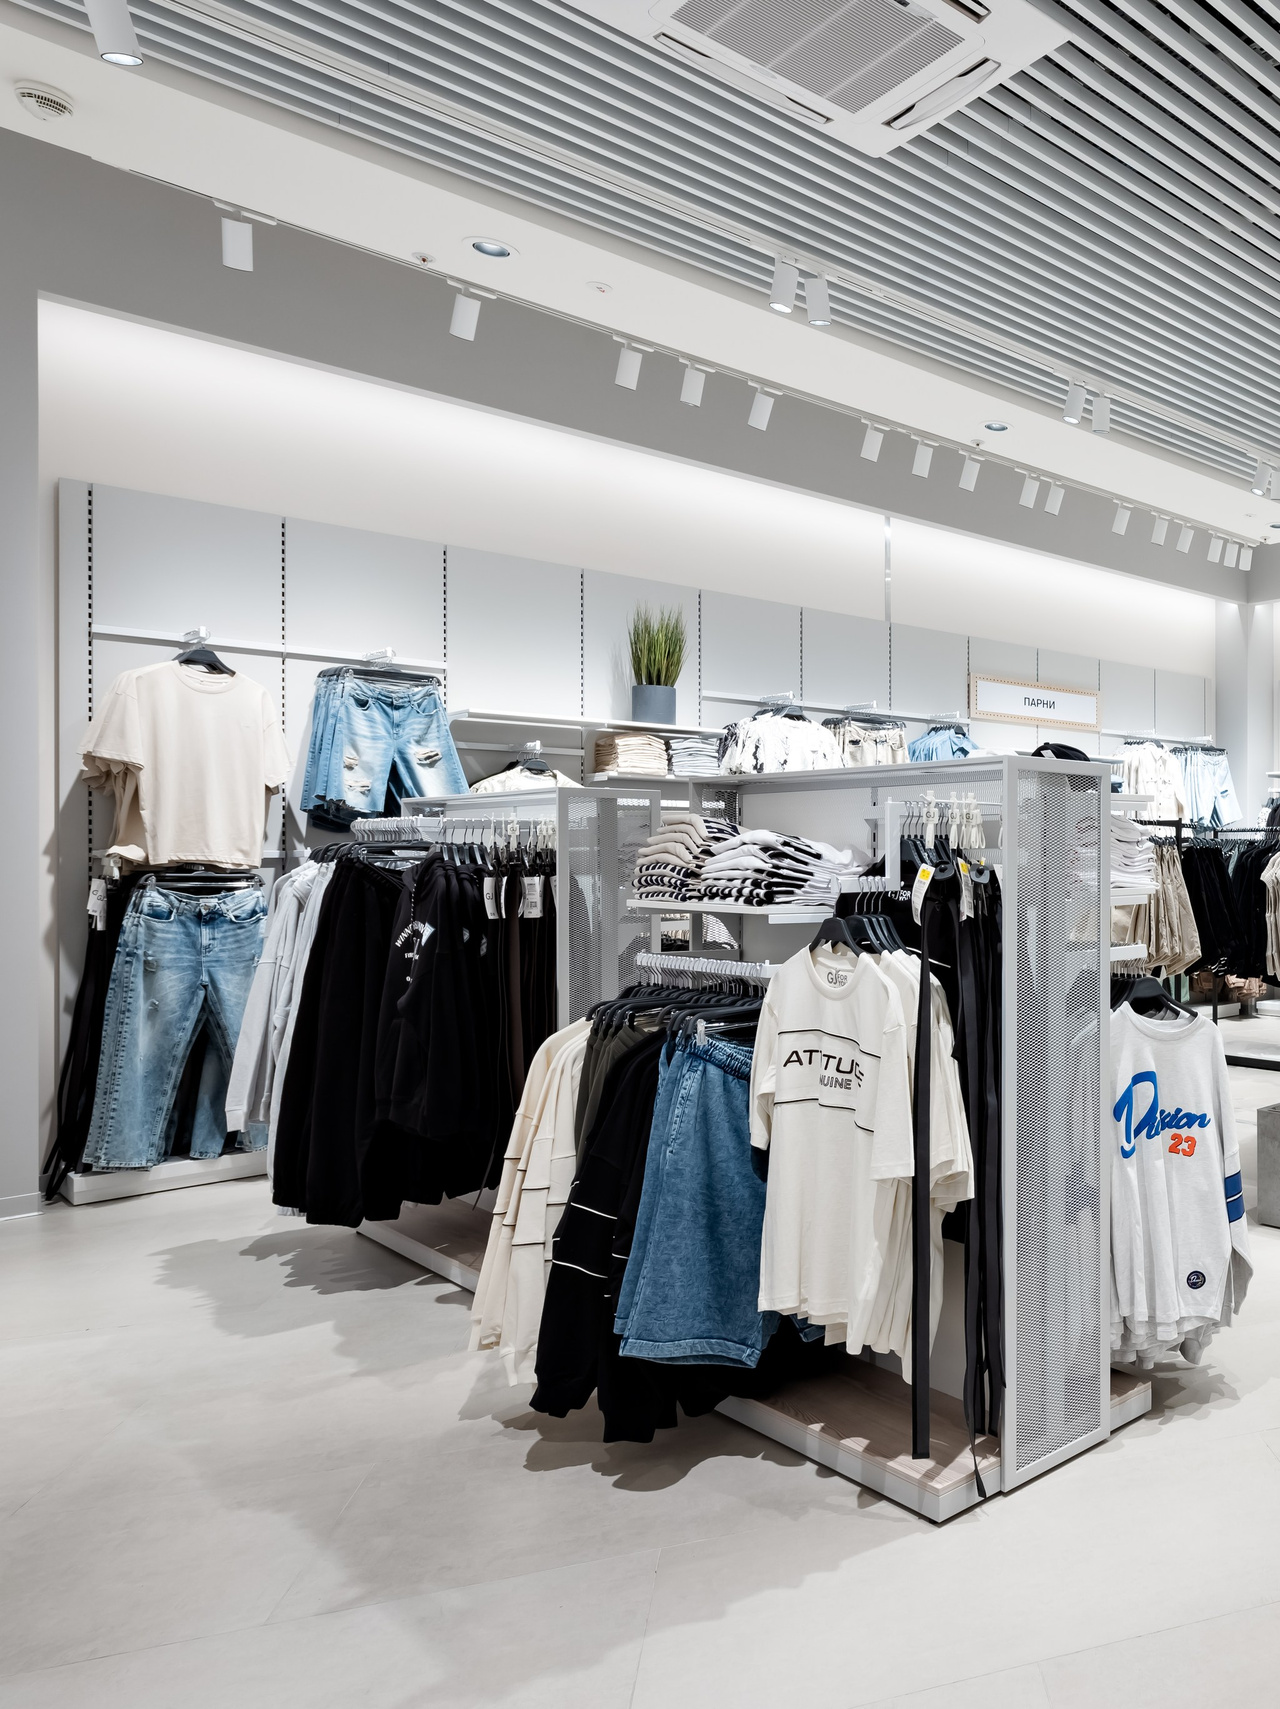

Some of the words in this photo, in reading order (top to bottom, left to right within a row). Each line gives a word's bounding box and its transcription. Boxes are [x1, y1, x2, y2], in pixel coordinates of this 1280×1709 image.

[1023, 696, 1056, 710] ПАРНИ
[485, 892, 495, 901] GJ
[838, 973, 848, 982] FOR
[1168, 1132, 1197, 1158] 23
